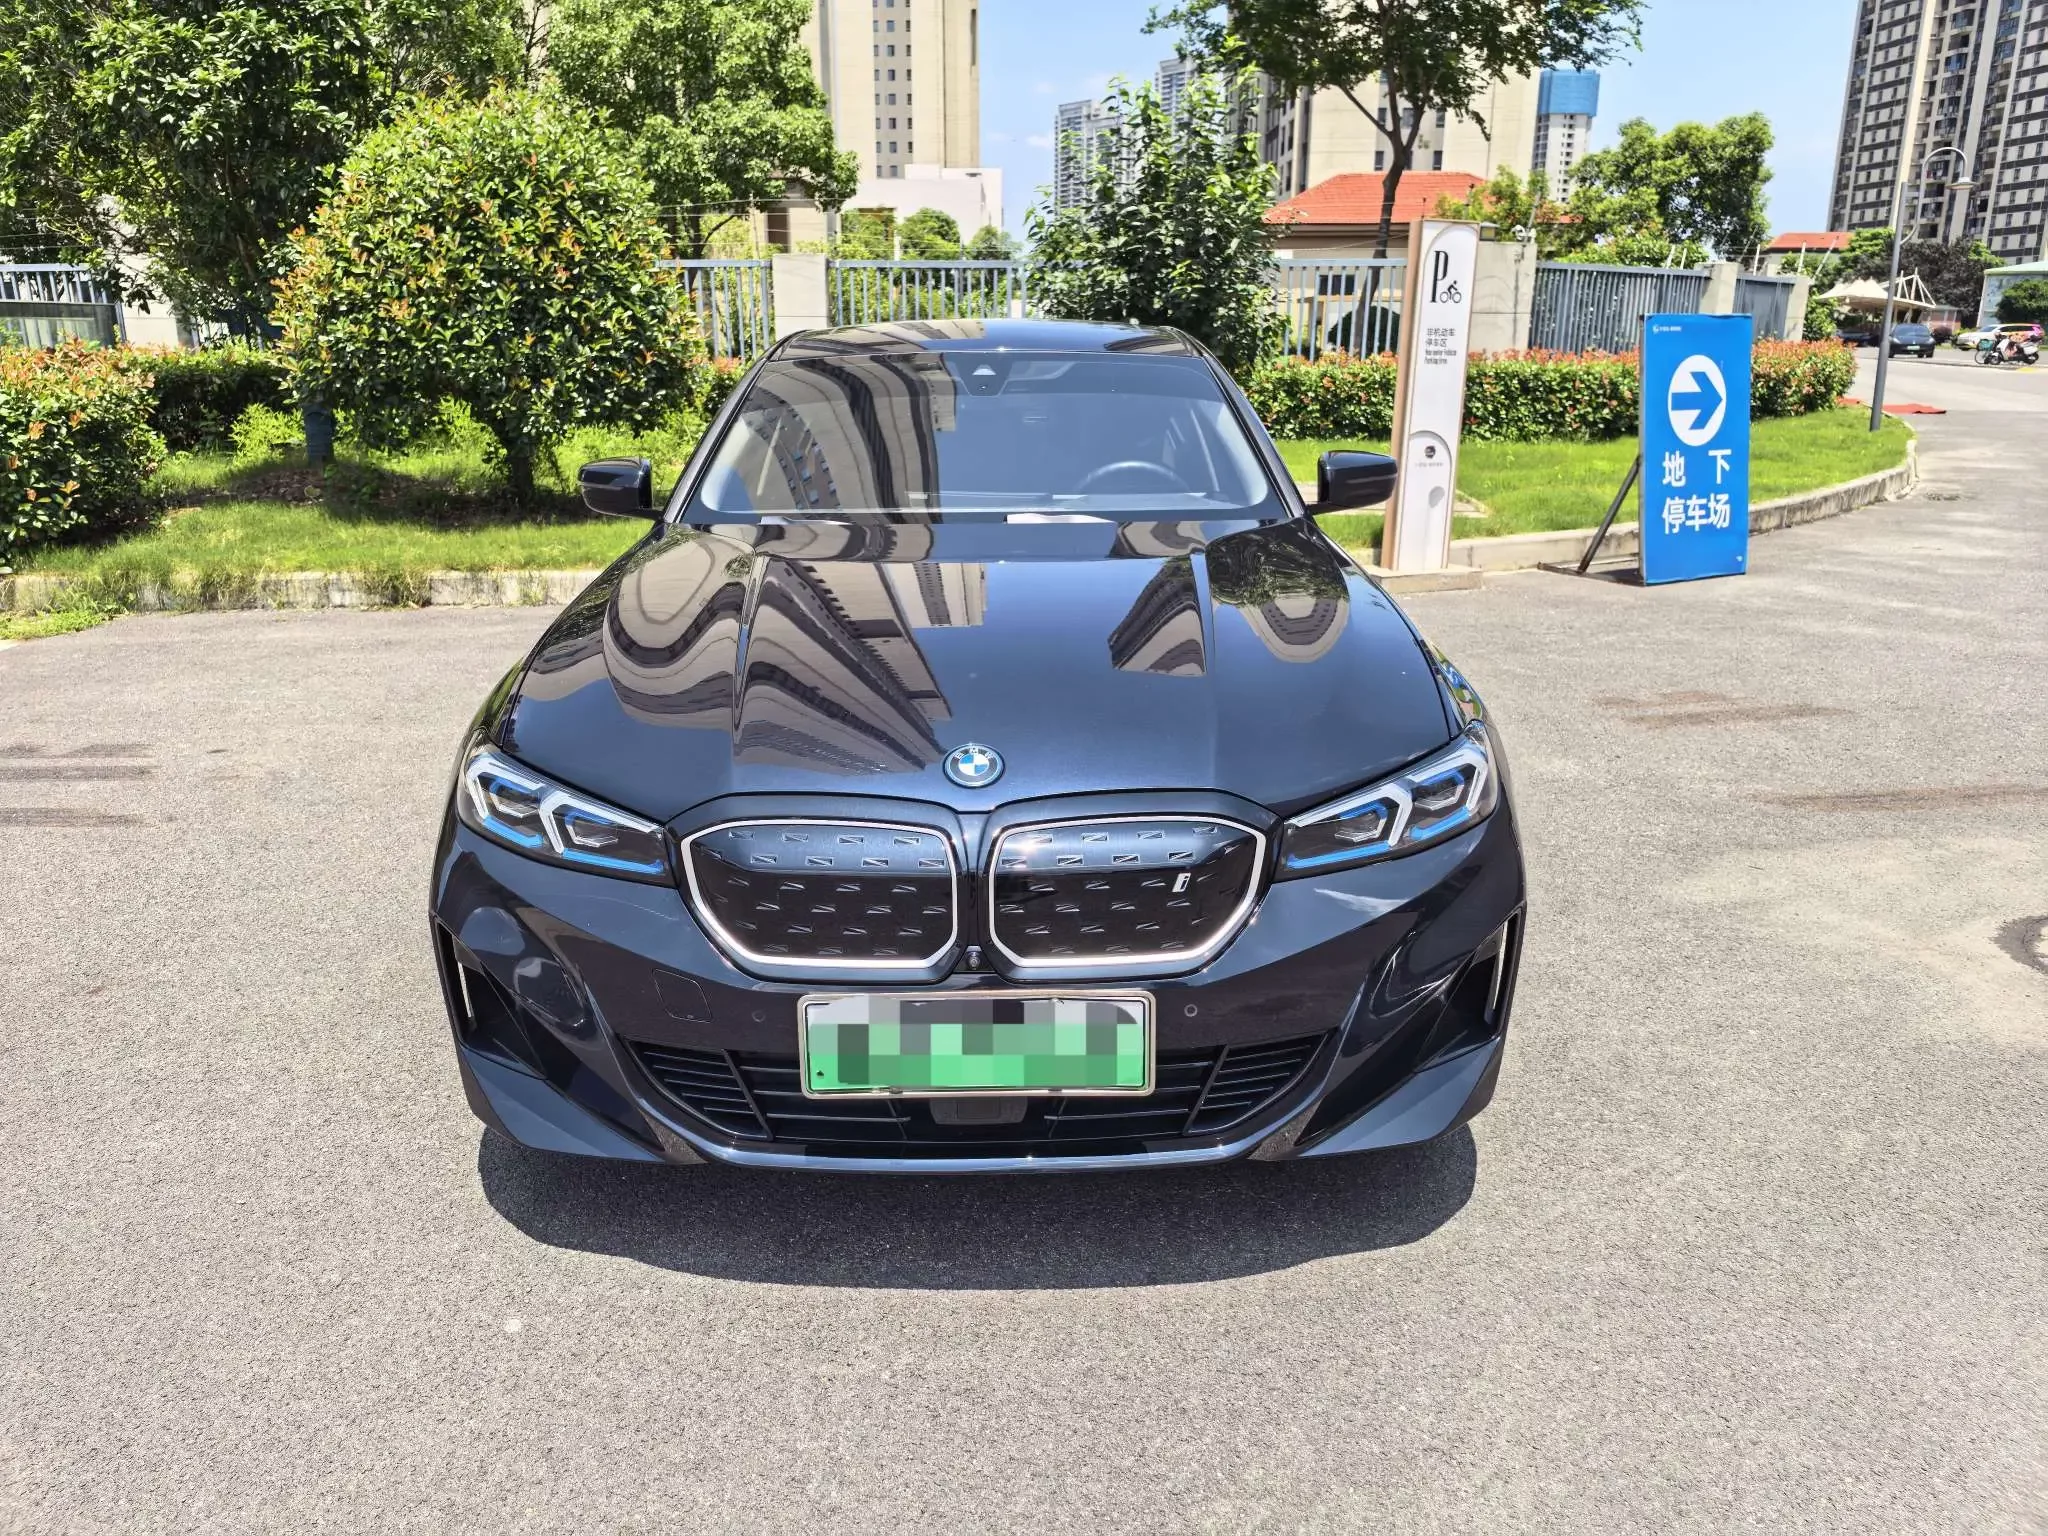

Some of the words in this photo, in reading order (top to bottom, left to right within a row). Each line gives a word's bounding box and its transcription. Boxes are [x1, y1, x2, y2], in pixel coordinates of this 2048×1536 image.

[1430, 250, 1449, 303] P
[1662, 493, 1730, 535] 停车场
[952, 746, 995, 760] BMW
